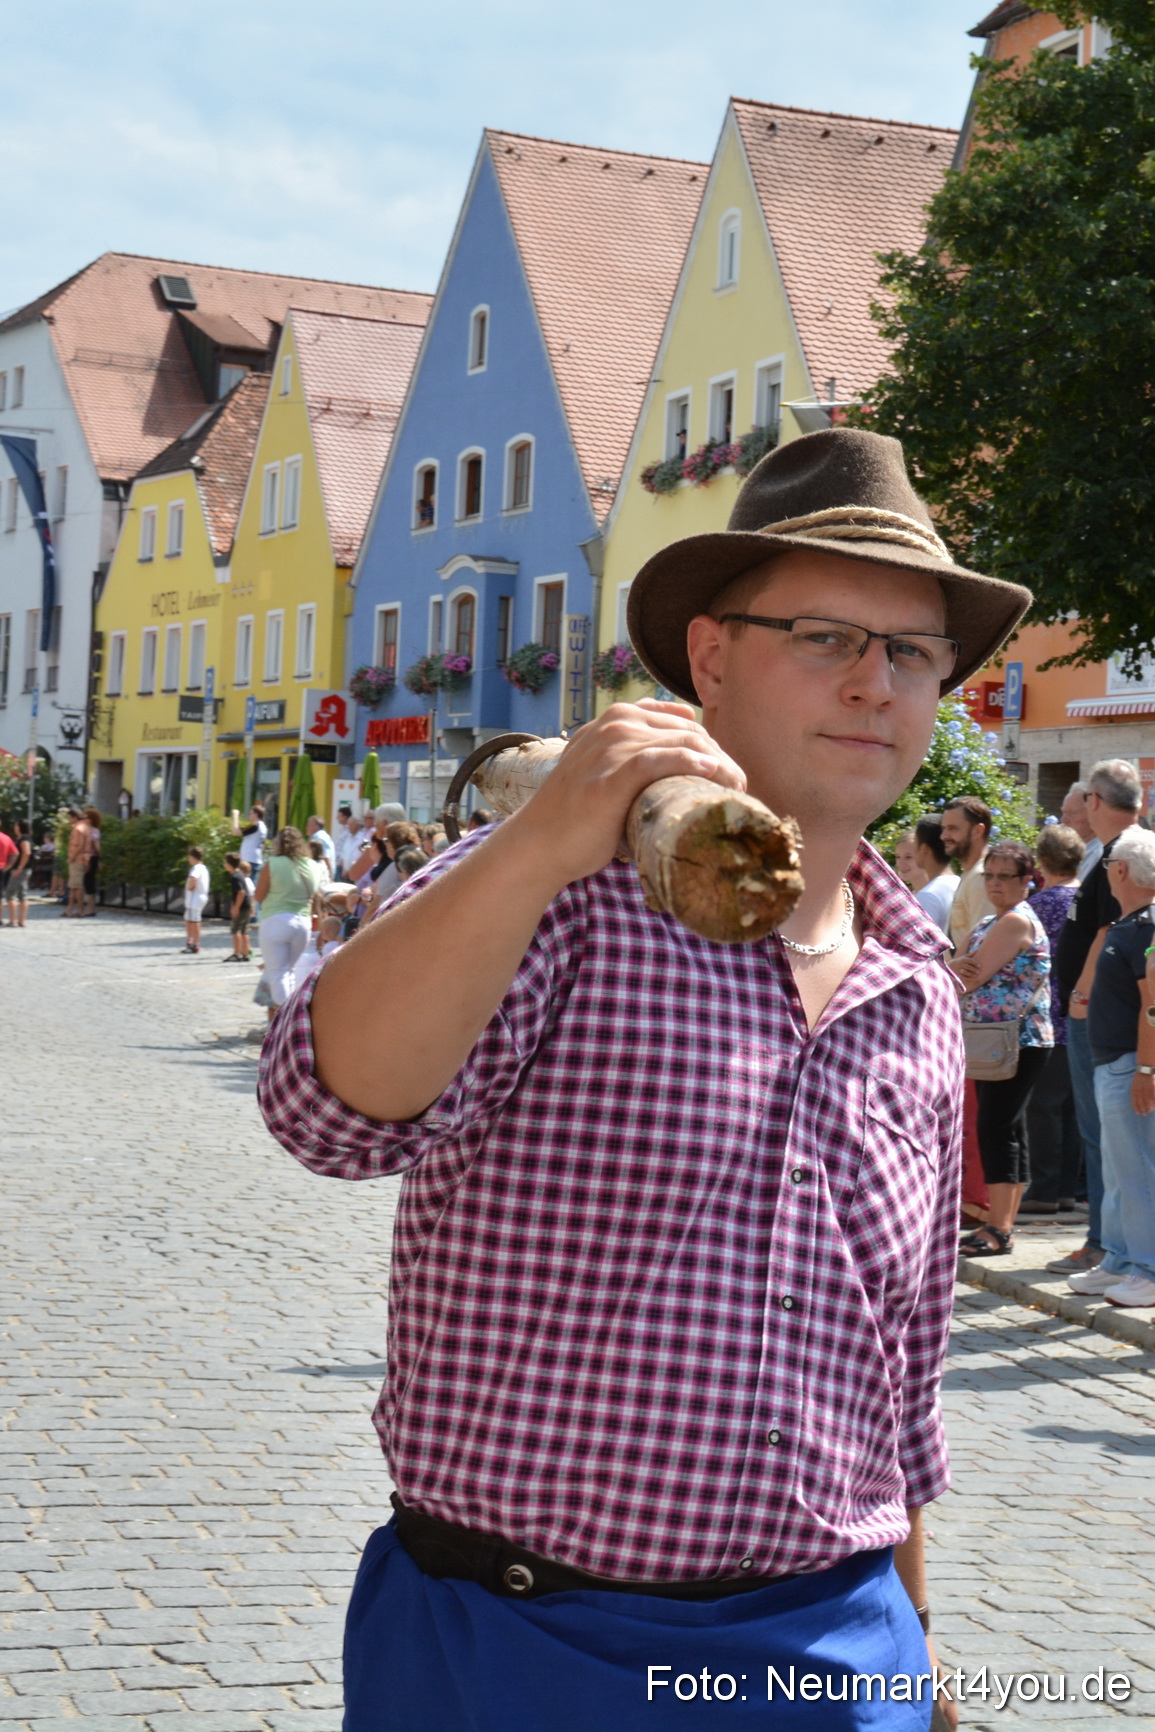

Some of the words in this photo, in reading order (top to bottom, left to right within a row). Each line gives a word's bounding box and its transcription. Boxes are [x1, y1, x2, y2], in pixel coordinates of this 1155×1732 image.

[151, 591, 180, 617] HOTEL
[1008, 669, 1019, 709] P
[364, 716, 430, 746] APOTHEK
